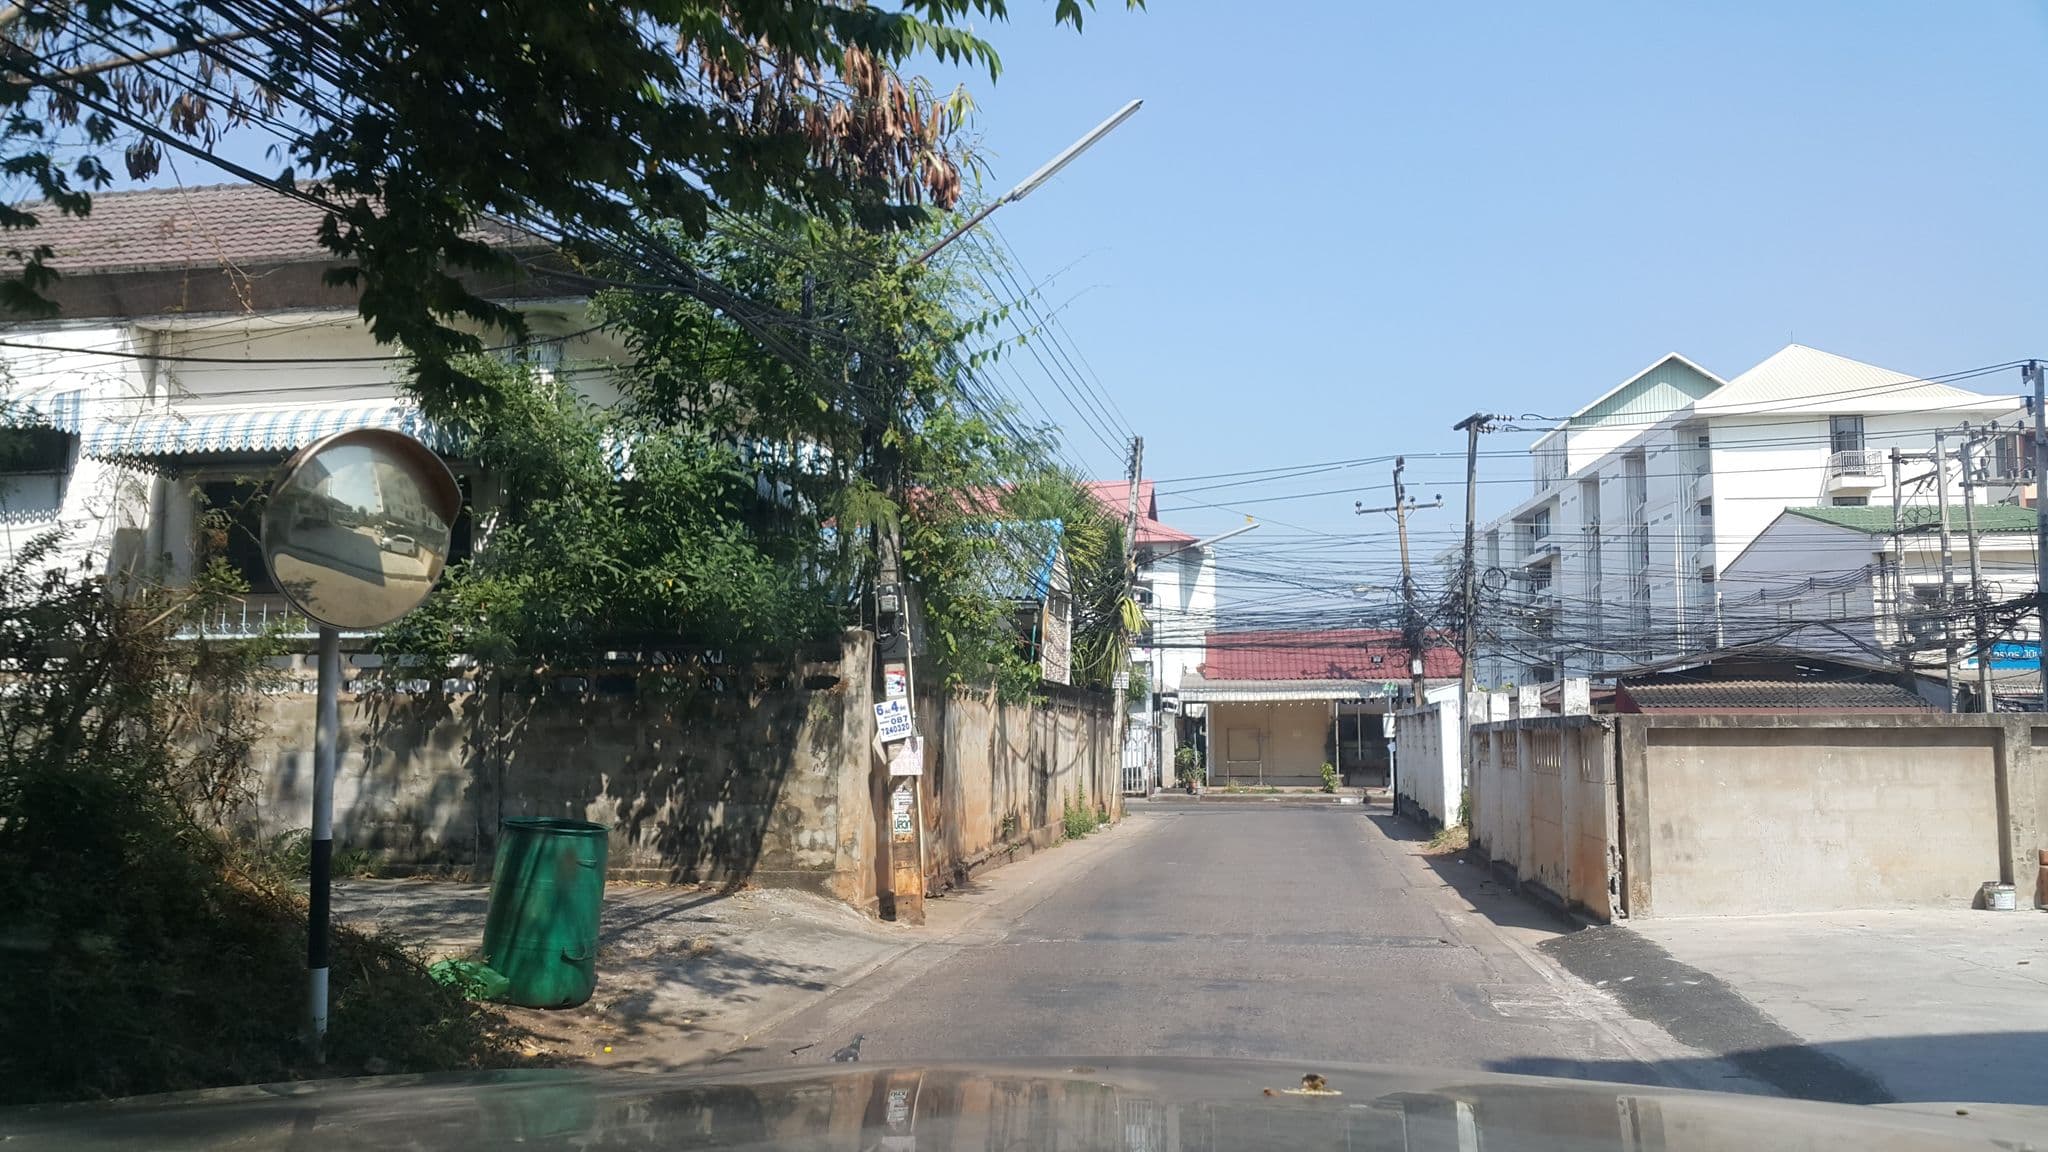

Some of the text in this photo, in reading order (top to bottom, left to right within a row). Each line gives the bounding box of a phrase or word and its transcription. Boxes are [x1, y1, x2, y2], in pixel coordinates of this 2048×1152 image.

[876, 704, 884, 716] 6
[891, 700, 899, 712] 4
[890, 715, 908, 725] 087
